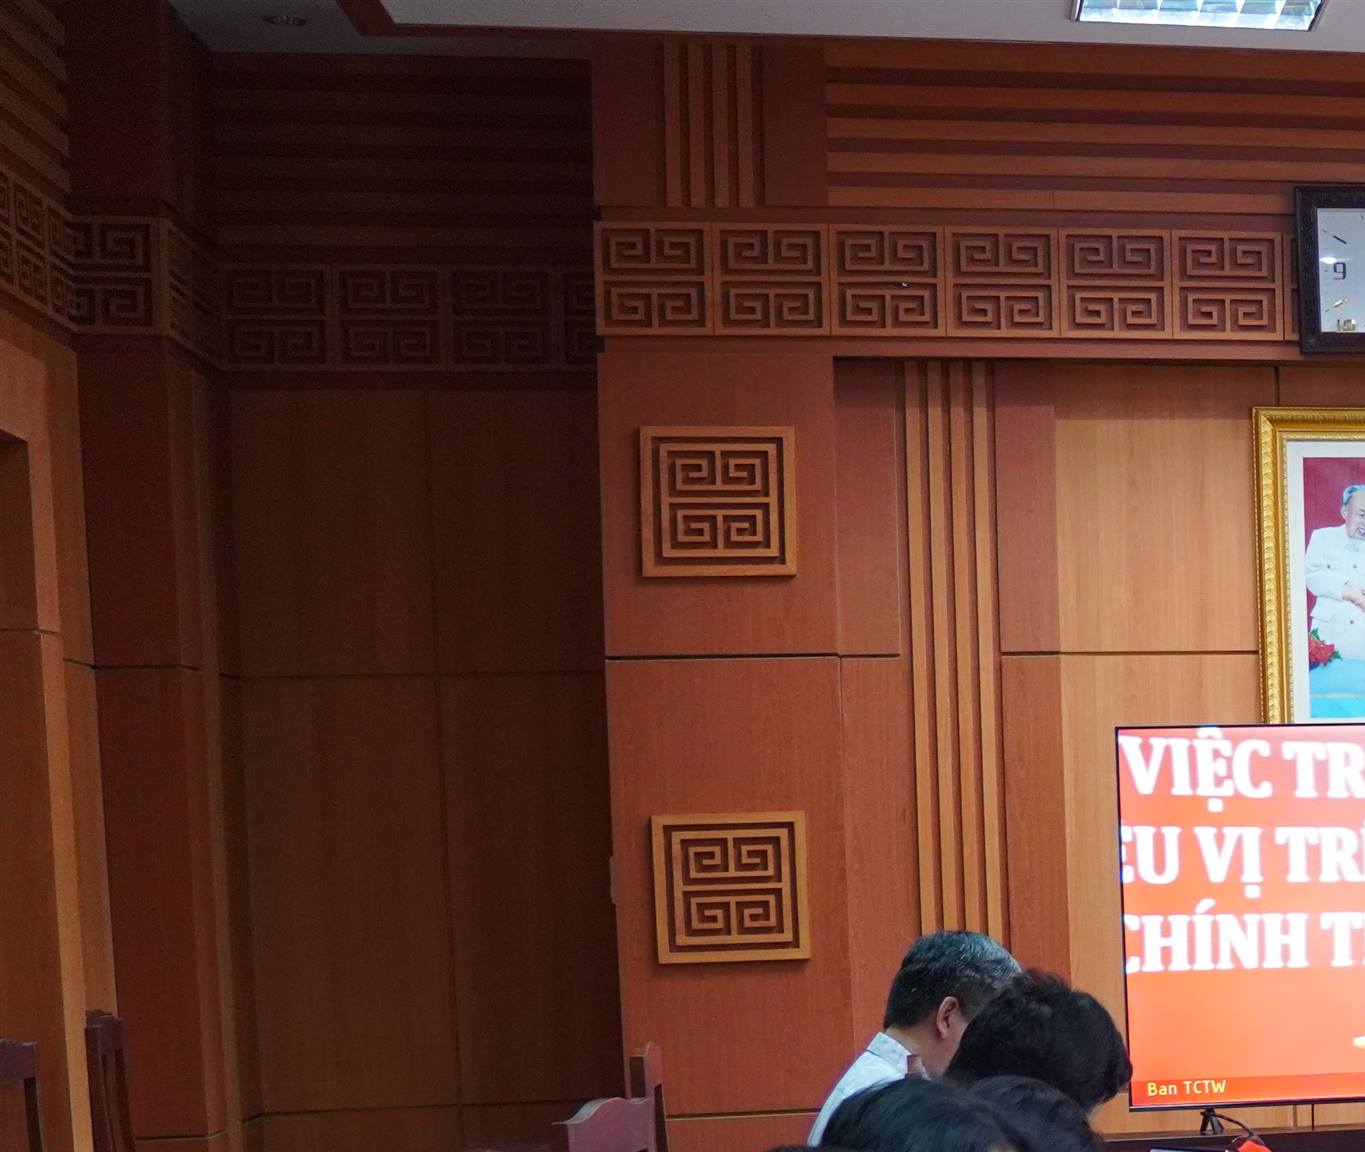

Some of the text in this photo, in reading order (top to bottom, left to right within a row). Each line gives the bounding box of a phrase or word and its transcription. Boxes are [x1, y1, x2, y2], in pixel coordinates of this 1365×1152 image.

[1333, 261, 1347, 280] 9
[1120, 727, 1272, 812] VIỆC
[1193, 825, 1263, 898] VỊ
[1147, 1079, 1227, 1097] Ban TCTW
